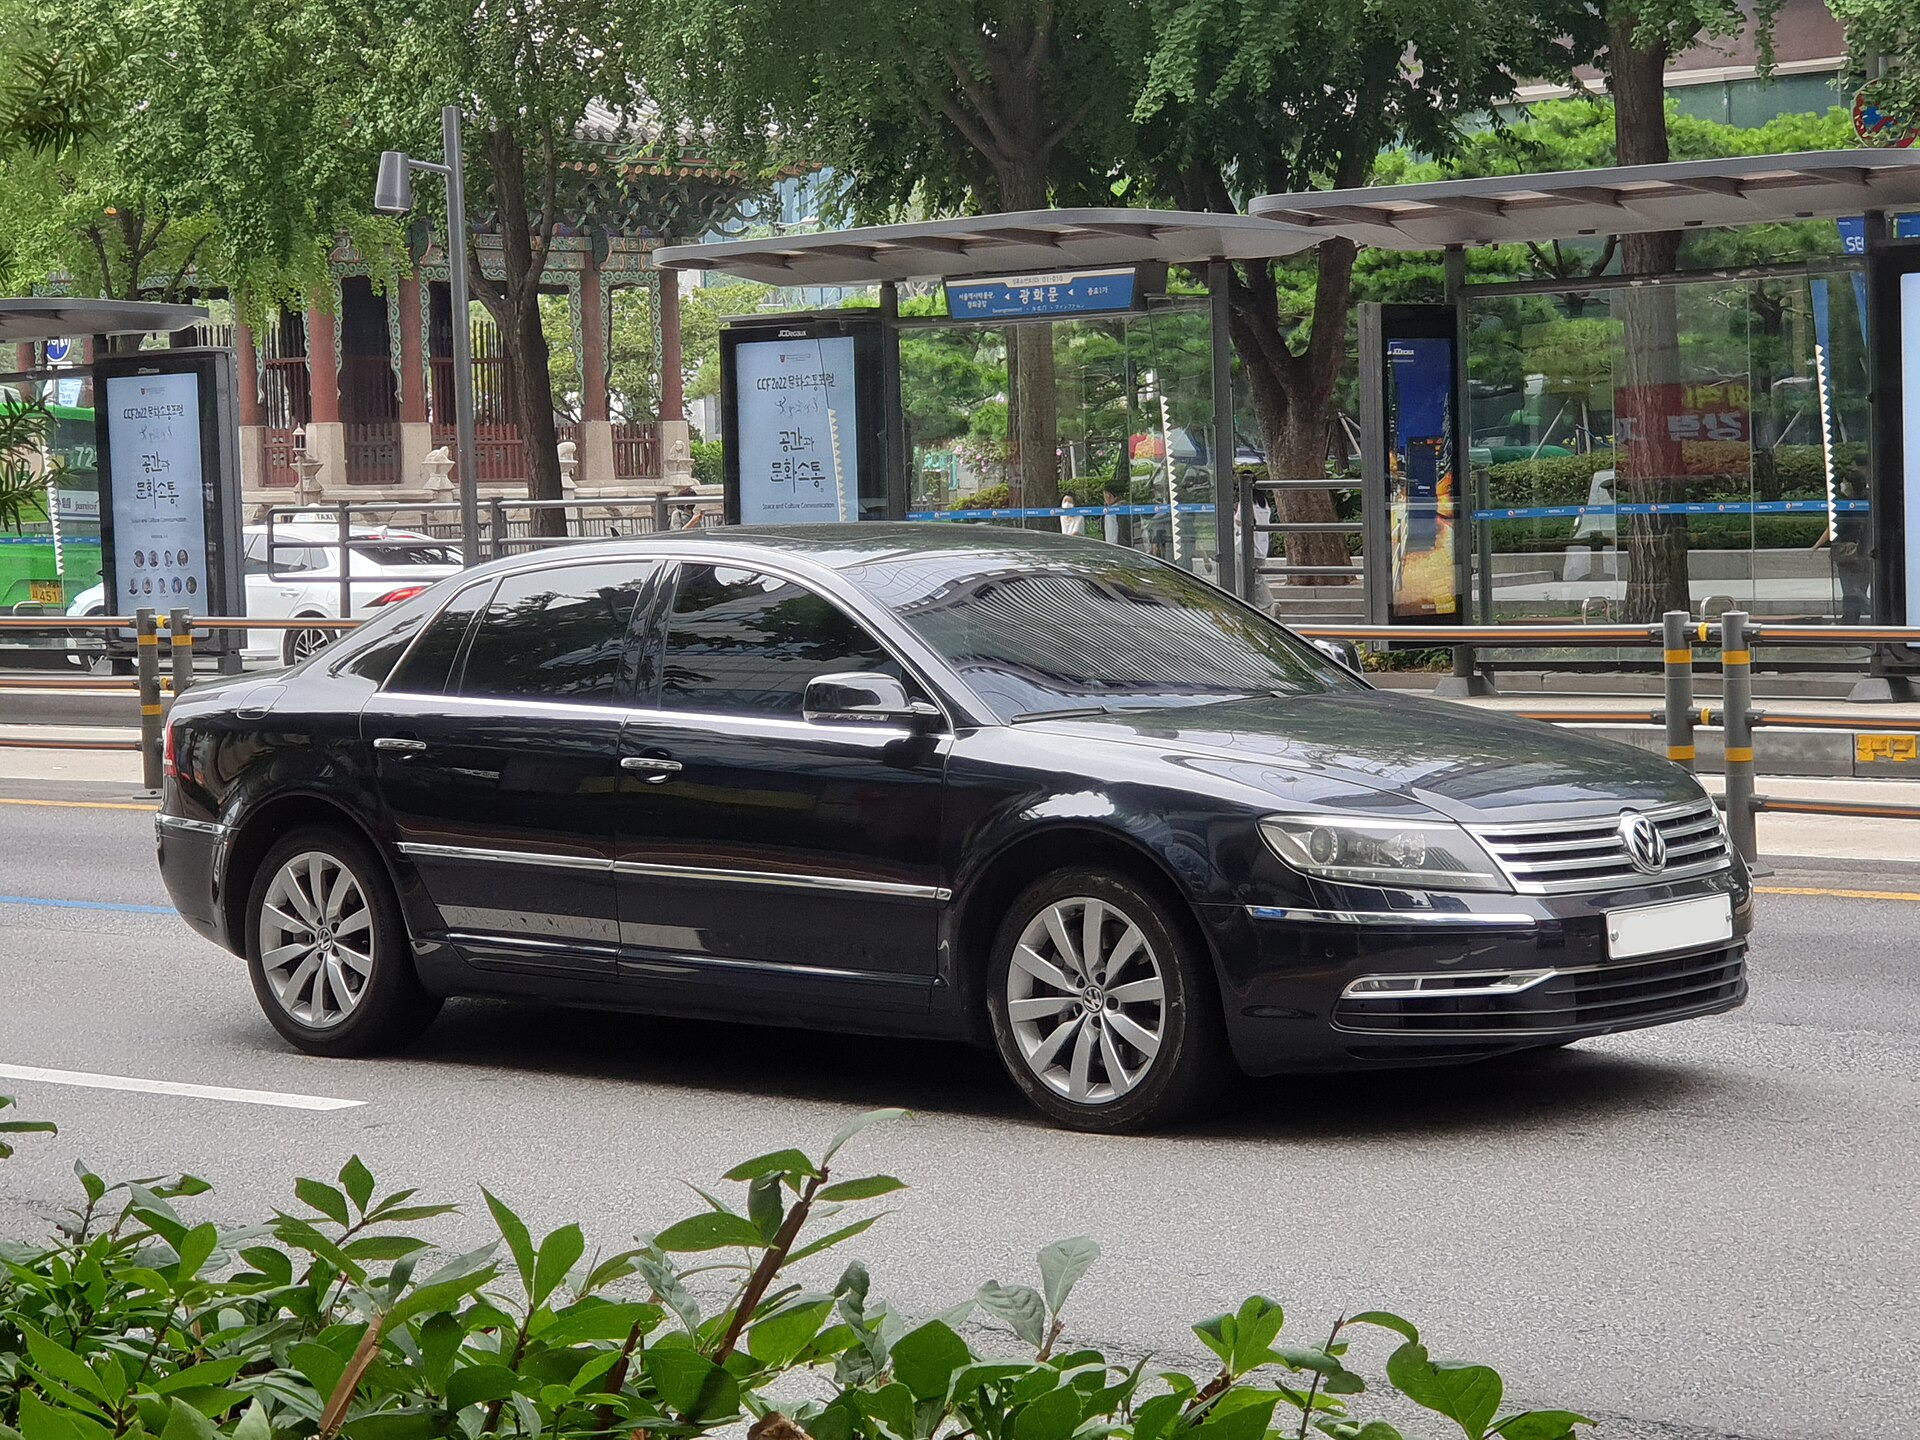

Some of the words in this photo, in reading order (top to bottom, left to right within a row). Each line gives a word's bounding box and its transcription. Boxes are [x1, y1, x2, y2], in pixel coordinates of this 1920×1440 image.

[1019, 287, 1060, 305] 광화문
[779, 426, 815, 453] 공간과
[74, 446, 98, 468] 72
[142, 451, 171, 474] 공간과
[770, 456, 826, 494] 문화소통
[136, 477, 180, 510] 문화소통
[315, 513, 334, 521] TAXI
